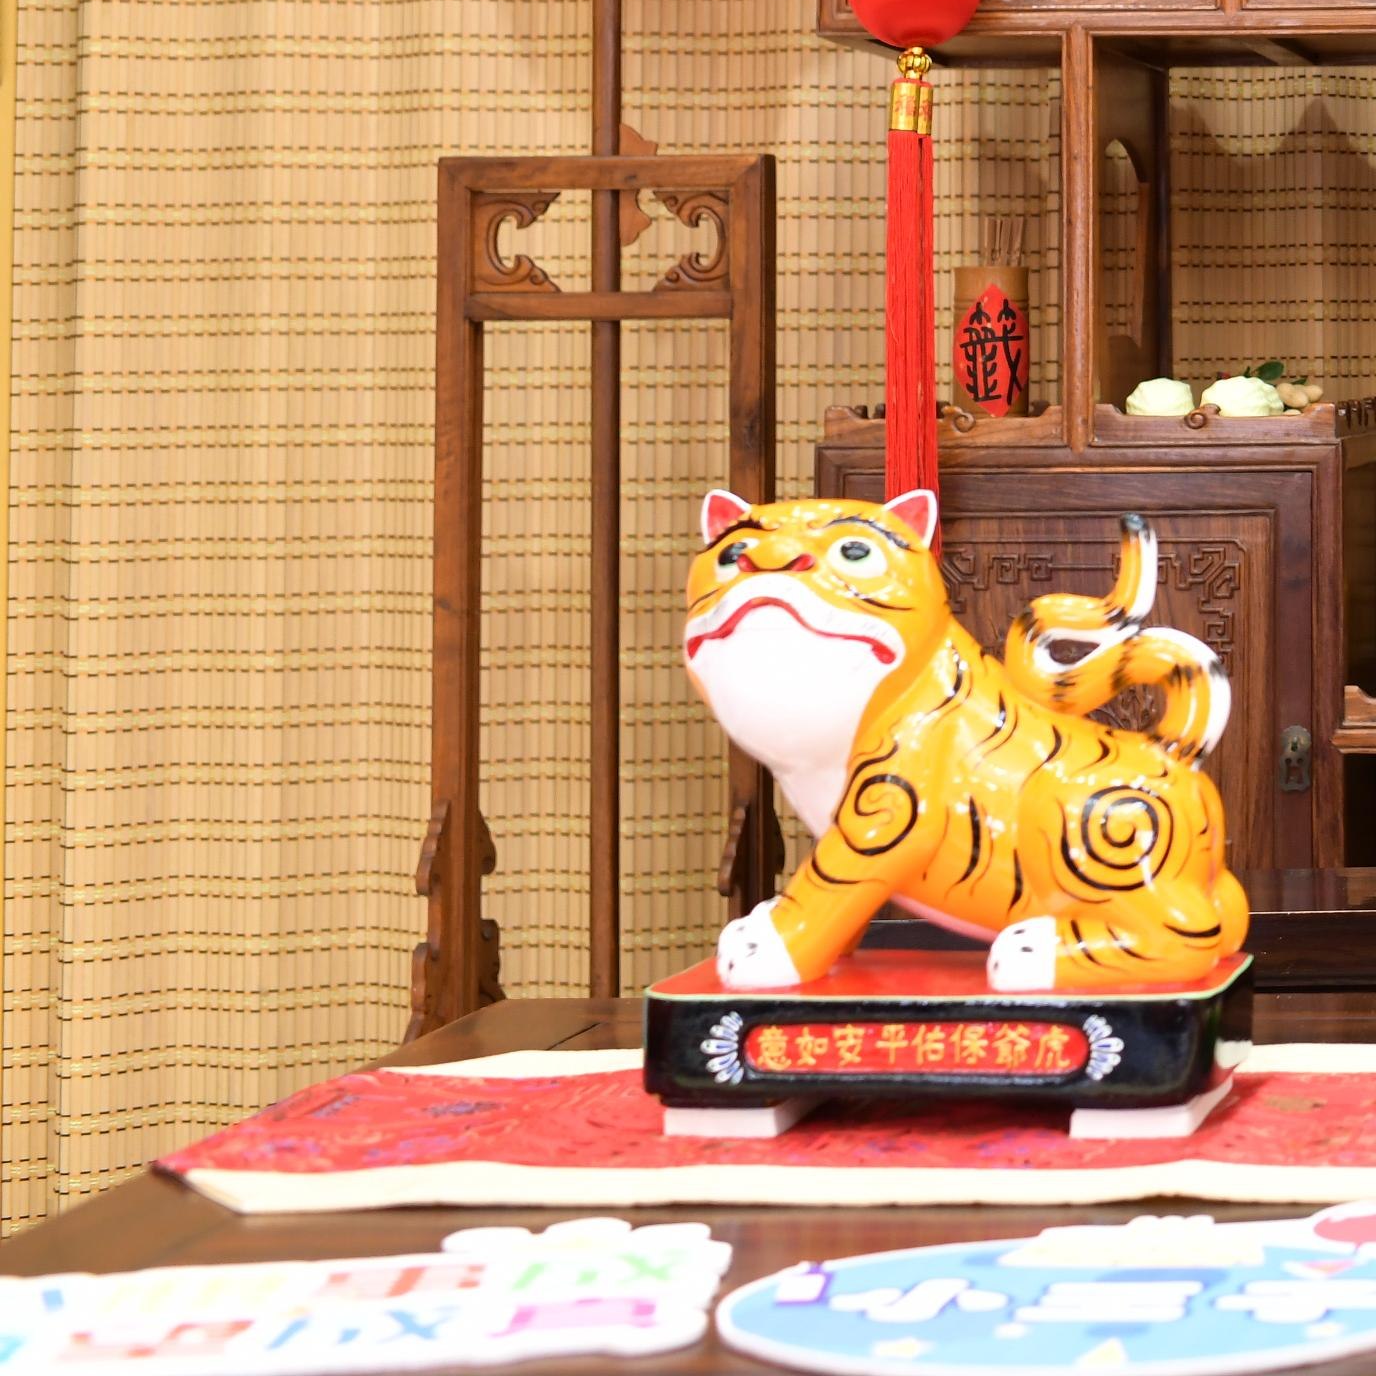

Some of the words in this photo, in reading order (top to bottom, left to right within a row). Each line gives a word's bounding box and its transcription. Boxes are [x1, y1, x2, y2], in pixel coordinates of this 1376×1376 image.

[756, 1024, 1071, 1071] 虎爺保佑平安如意
